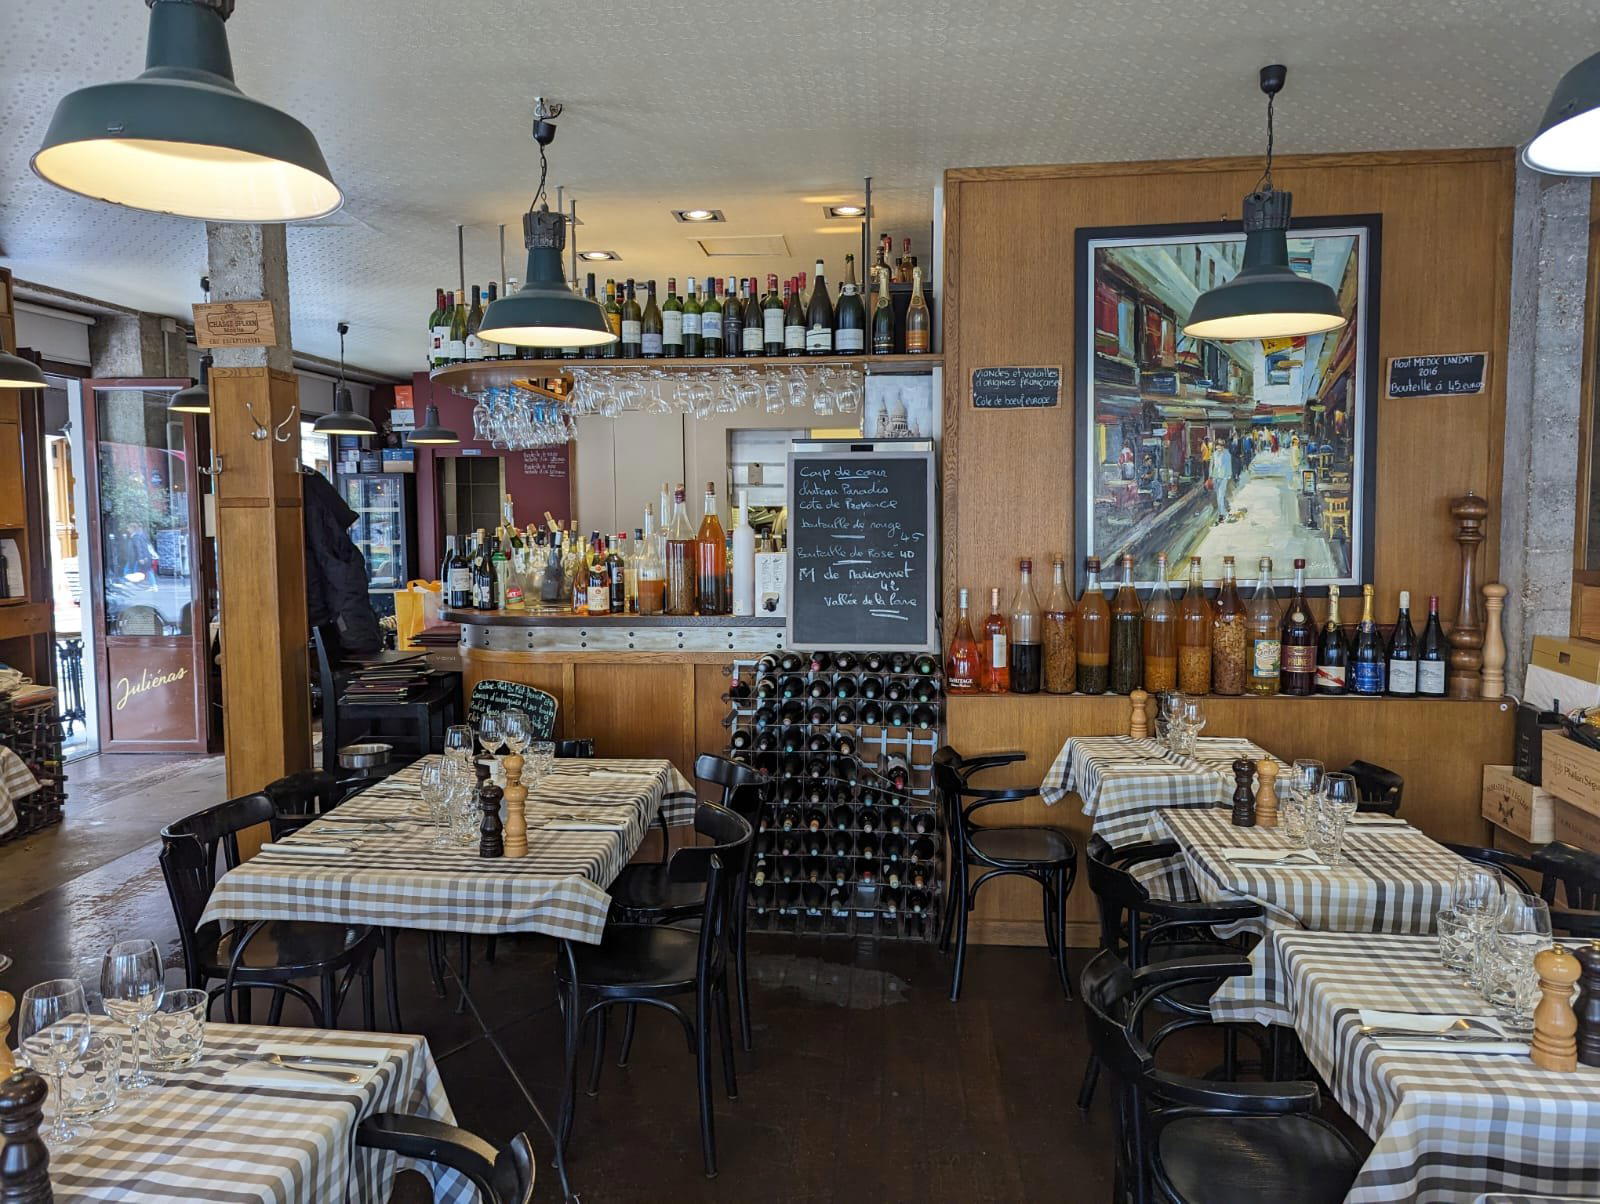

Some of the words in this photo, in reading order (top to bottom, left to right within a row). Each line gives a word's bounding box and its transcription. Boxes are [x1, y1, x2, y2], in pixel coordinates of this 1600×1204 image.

[1012, 368, 1021, 378] et
[1418, 366, 1438, 377] 2016
[1391, 378, 1432, 392] Bouteille
[1448, 380, 1461, 391] 45
[800, 466, 831, 482] Coup
[834, 466, 851, 477] de
[842, 481, 889, 495] Paradis
[825, 498, 840, 509] de
[844, 498, 898, 510] Provence
[852, 519, 865, 530] de
[870, 522, 902, 538] rouge
[900, 531, 925, 543] 45
[849, 546, 863, 558] de
[900, 549, 915, 558] 40
[799, 567, 815, 582] M
[823, 566, 840, 580] de
[823, 592, 858, 607] Vallée
[862, 594, 874, 605] de
[874, 592, 886, 605] la
[116, 667, 188, 711] Juliénas
